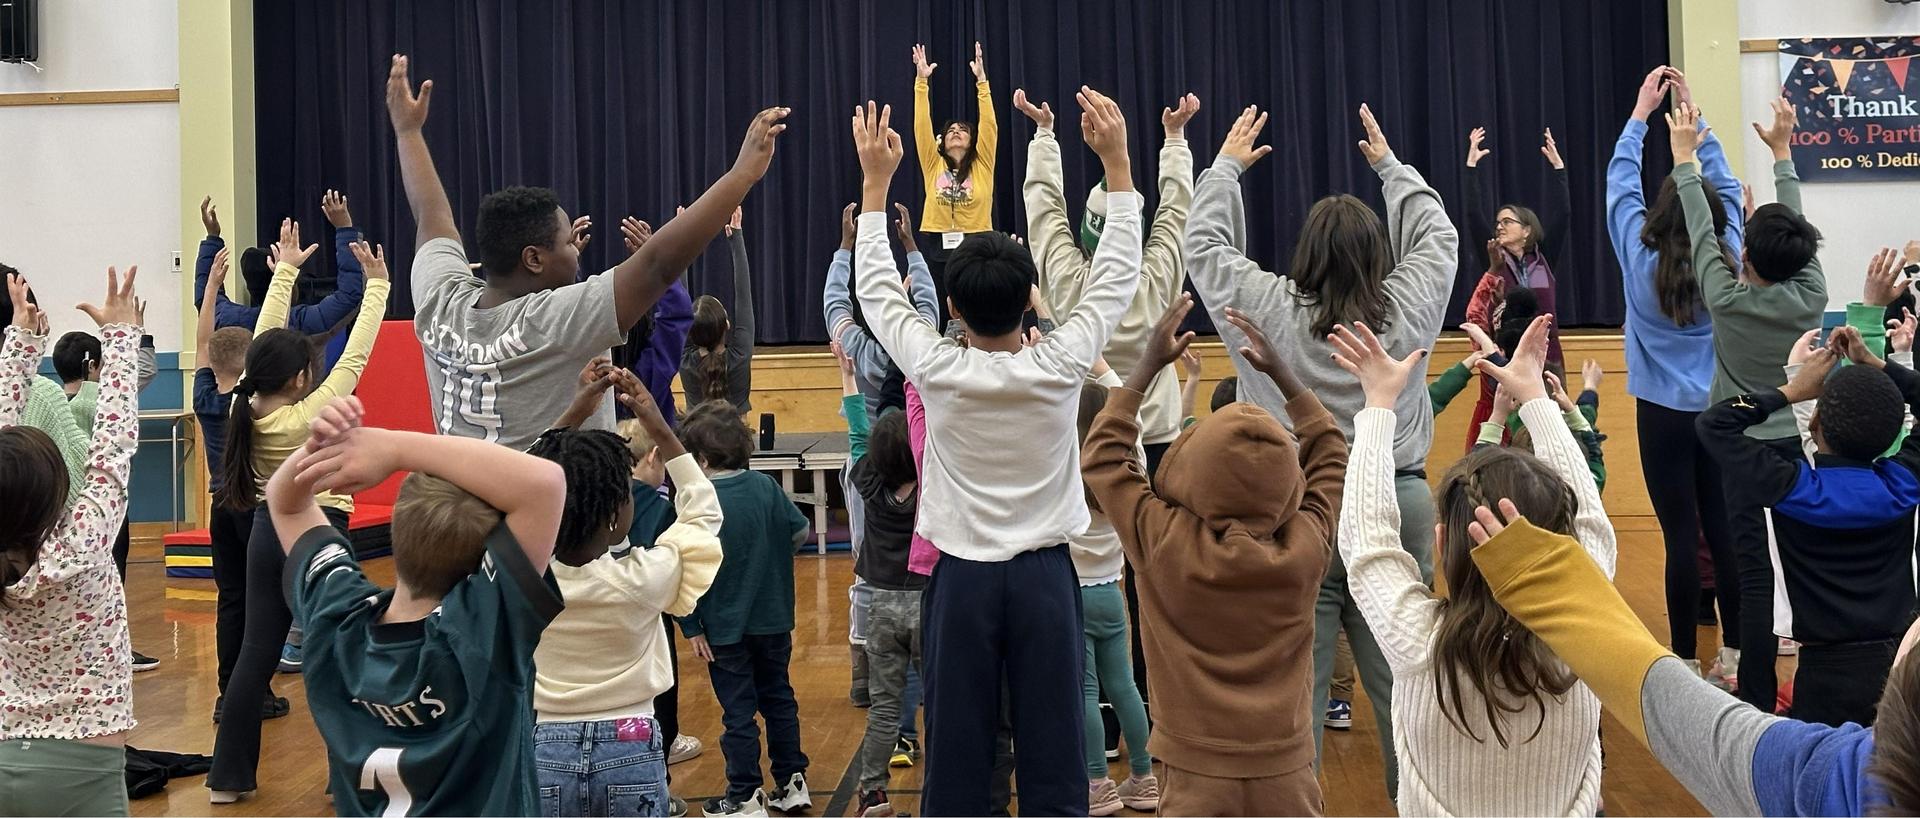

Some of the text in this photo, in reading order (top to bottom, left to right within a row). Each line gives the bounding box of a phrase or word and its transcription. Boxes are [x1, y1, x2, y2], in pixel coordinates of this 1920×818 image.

[1826, 93, 1919, 118] Thank
[1838, 126, 1859, 145] %
[1821, 151, 1920, 169] 100 % Dedi
